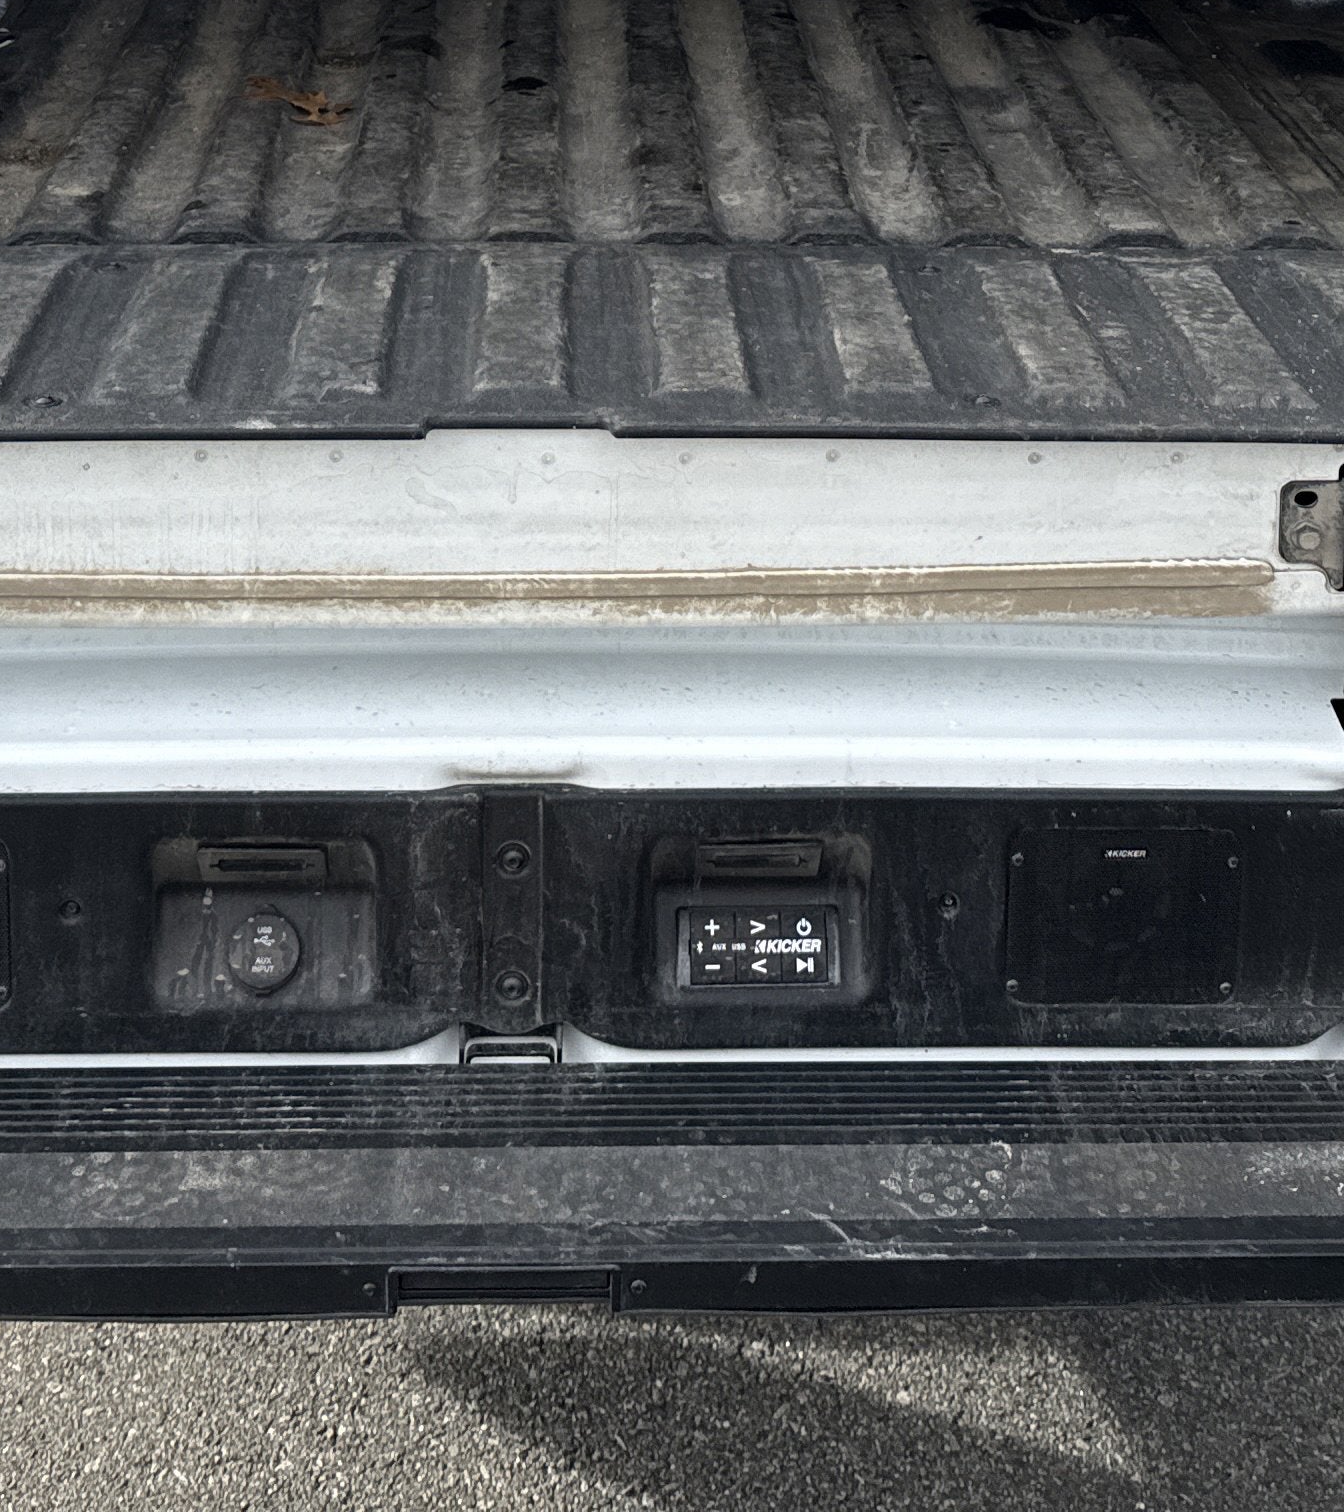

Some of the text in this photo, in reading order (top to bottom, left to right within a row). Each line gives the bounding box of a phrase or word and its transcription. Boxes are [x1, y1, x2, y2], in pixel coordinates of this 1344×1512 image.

[1111, 849, 1147, 858] KICKER
[257, 926, 273, 934] USB
[712, 942, 747, 951] AUX USB
[766, 938, 822, 954] KICKER
[255, 956, 272, 965] AUX
[251, 964, 275, 973] INPUT
